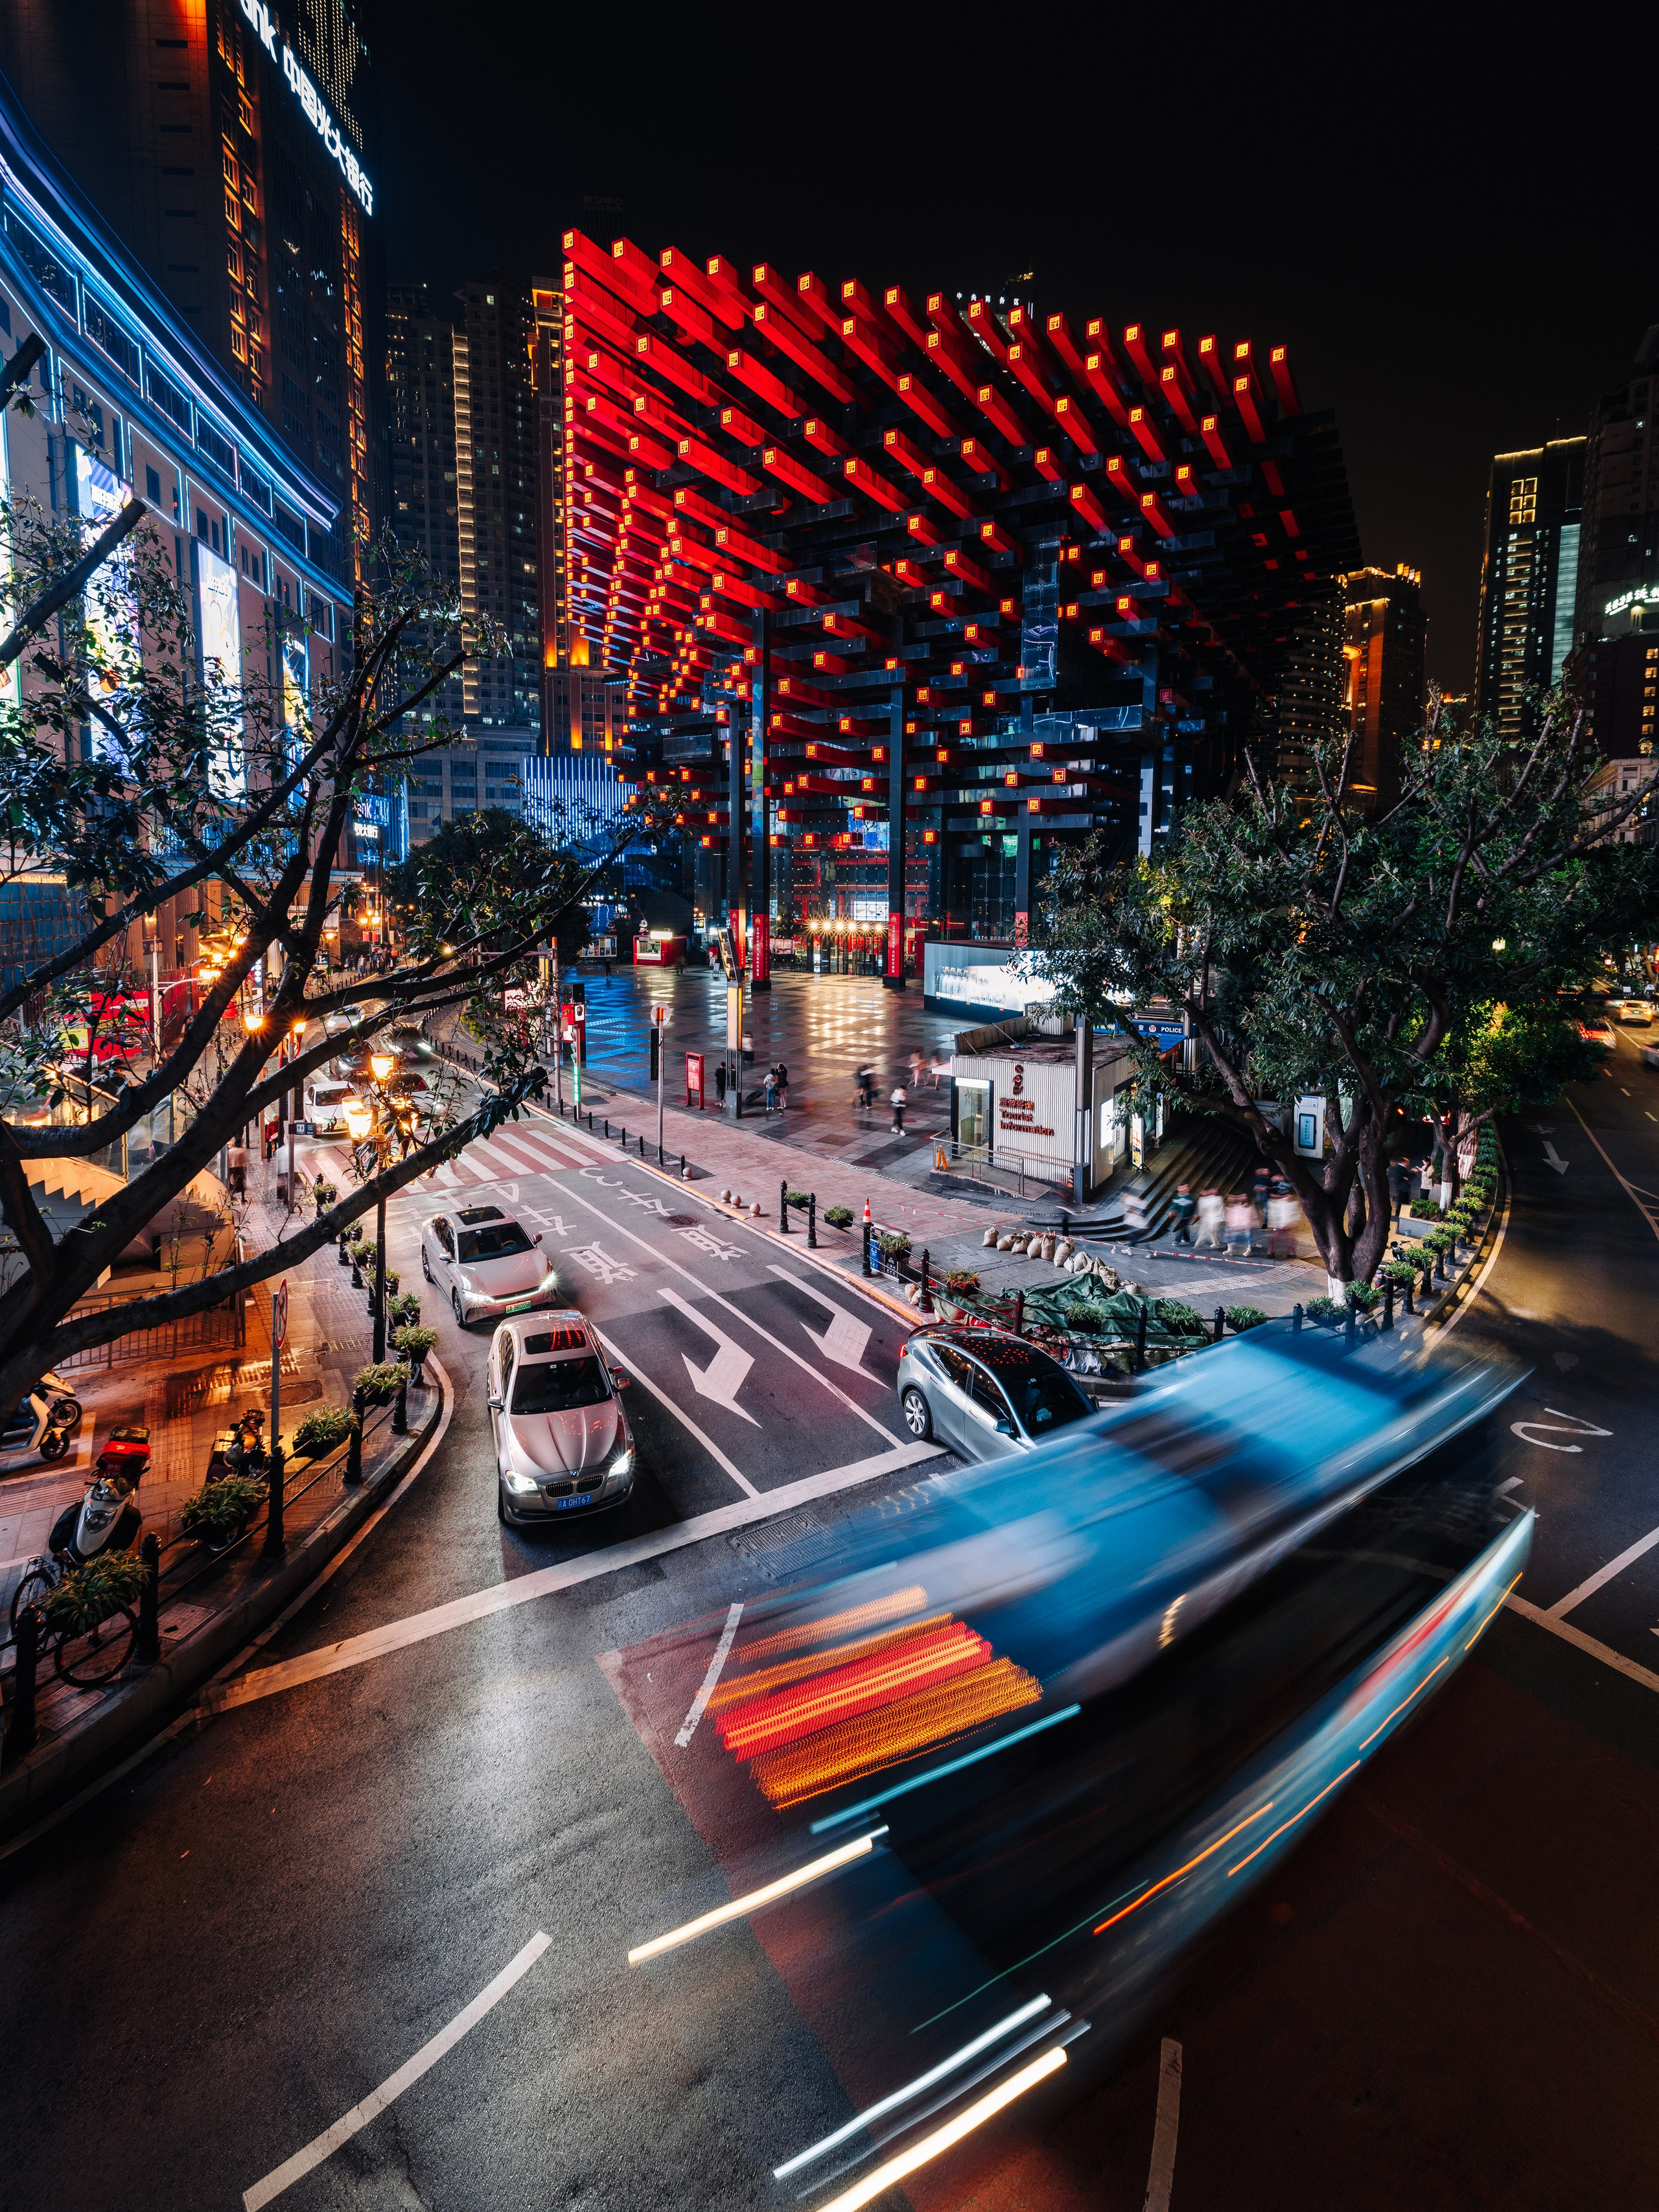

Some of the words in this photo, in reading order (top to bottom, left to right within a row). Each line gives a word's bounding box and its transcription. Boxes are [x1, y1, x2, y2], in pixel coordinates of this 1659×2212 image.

[283, 45, 373, 216] 中国光大银行
[957, 292, 1019, 306] 中央商务区
[999, 1097, 1034, 1111] 旅游咨询
[999, 1109, 1033, 1123] Tourist
[1000, 1120, 1054, 1137] Information
